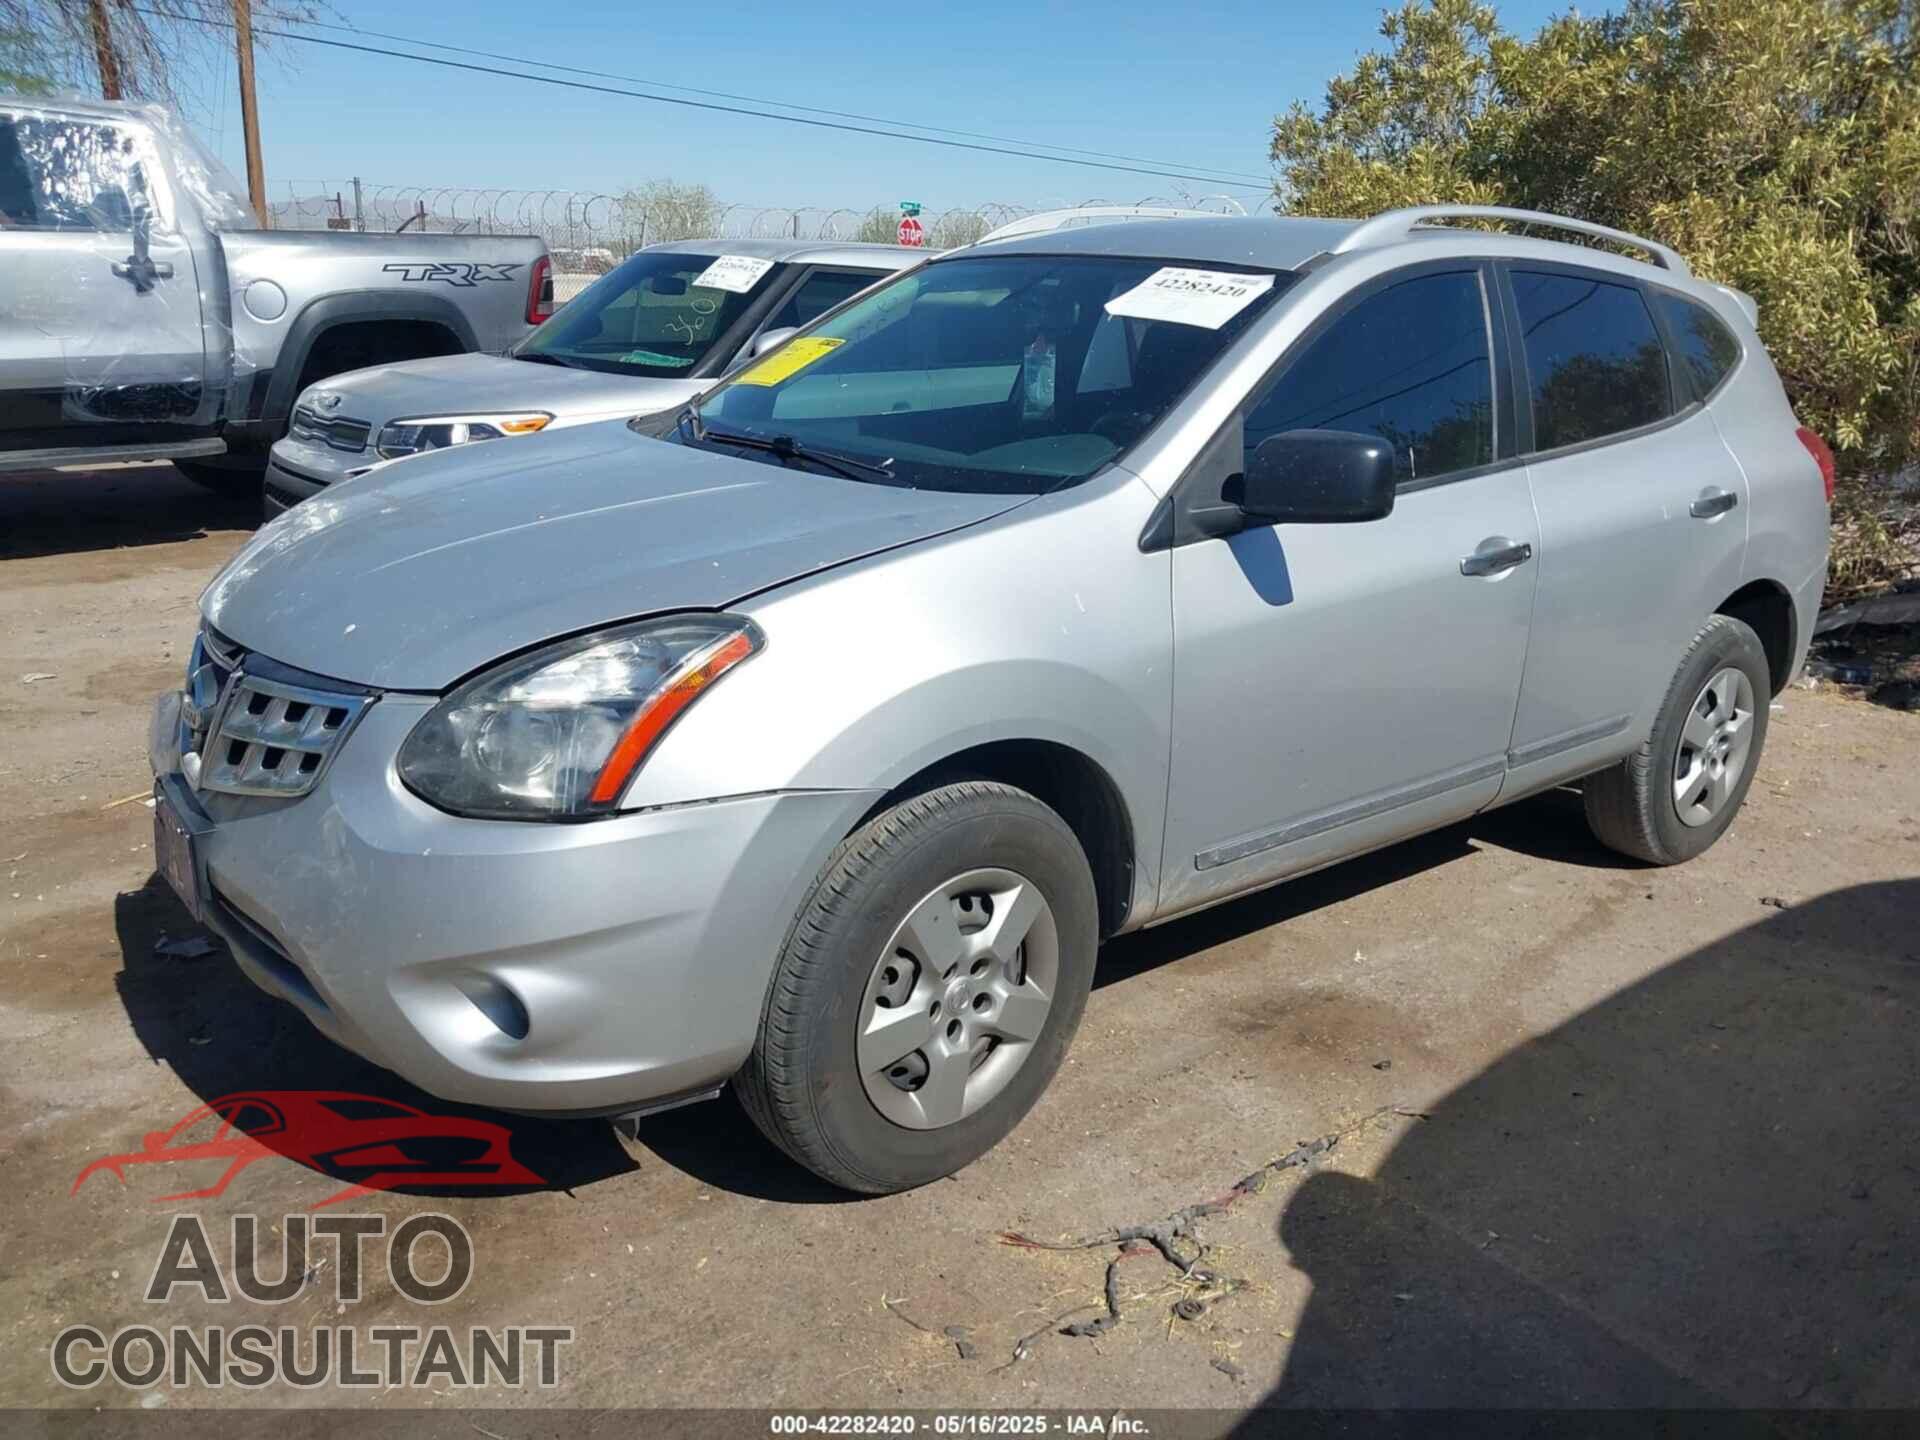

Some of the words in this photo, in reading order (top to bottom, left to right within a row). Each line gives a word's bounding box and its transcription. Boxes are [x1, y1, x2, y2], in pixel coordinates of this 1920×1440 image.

[899, 229, 922, 241] STOP
[382, 263, 525, 287] TRX
[1155, 278, 1248, 297] 42282420
